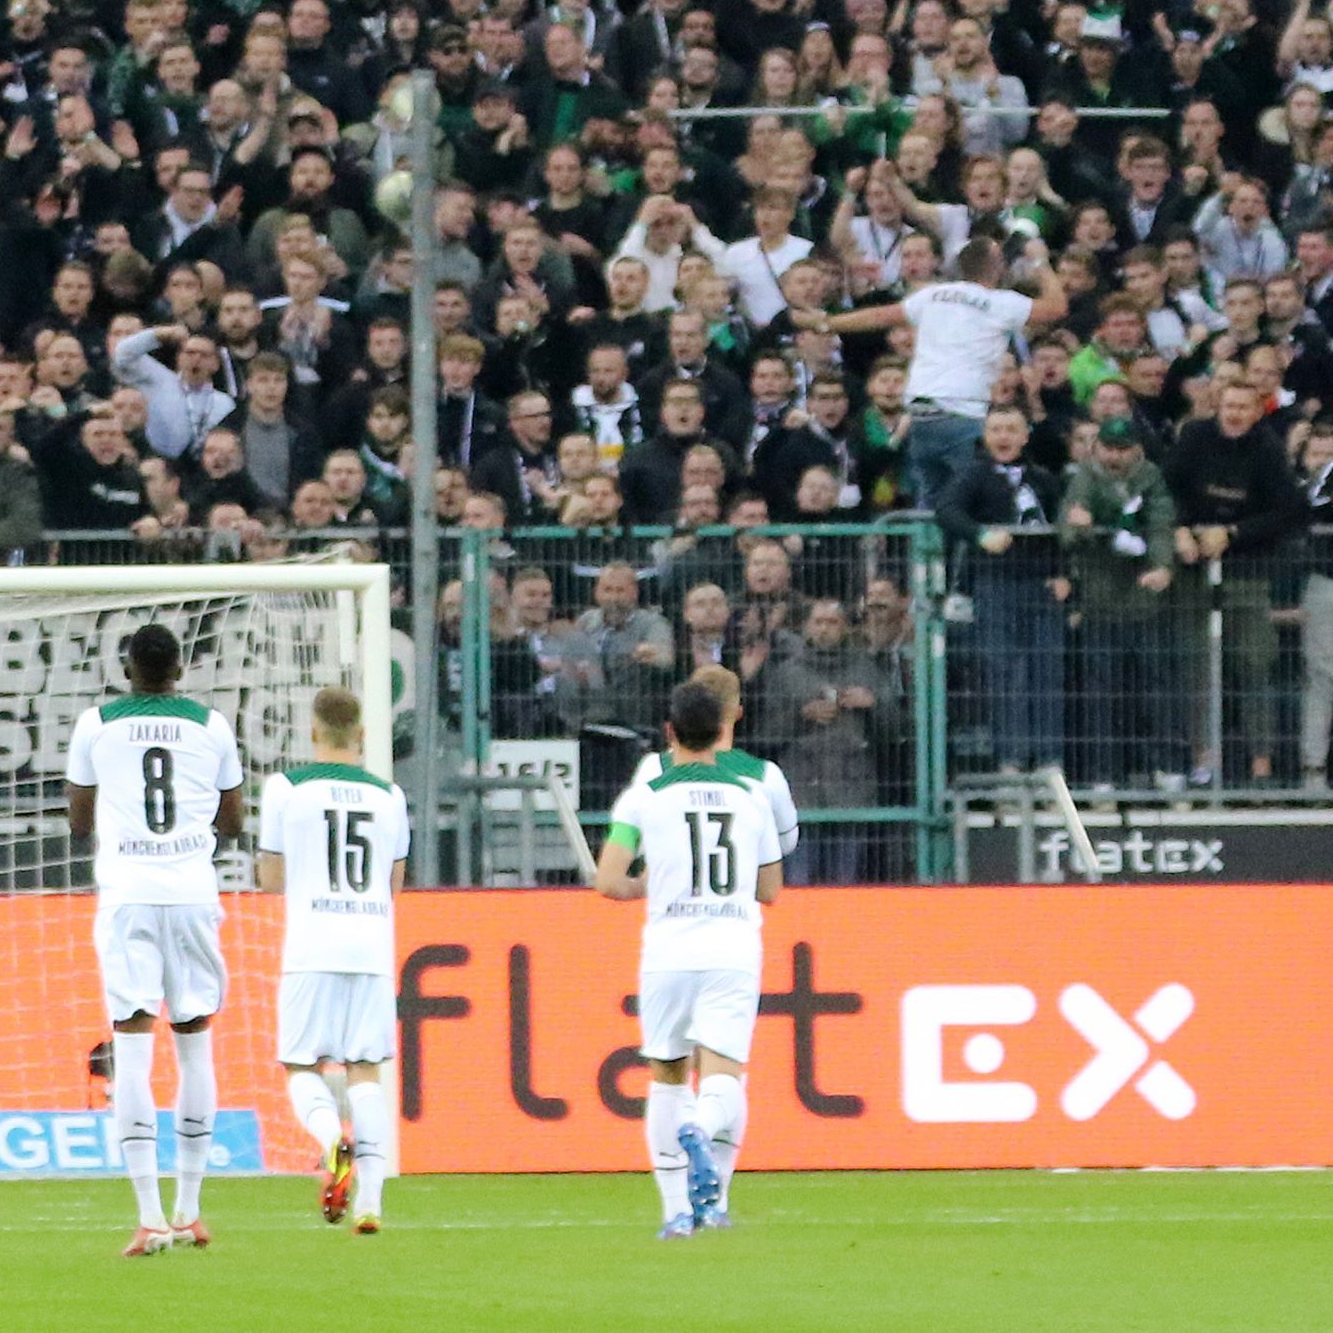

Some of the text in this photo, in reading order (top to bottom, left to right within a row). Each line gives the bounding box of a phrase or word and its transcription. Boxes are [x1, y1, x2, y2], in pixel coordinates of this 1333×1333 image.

[129, 724, 182, 742] ZAKARIA
[143, 746, 176, 835] 8
[324, 809, 374, 894] 15
[684, 812, 736, 897] 13
